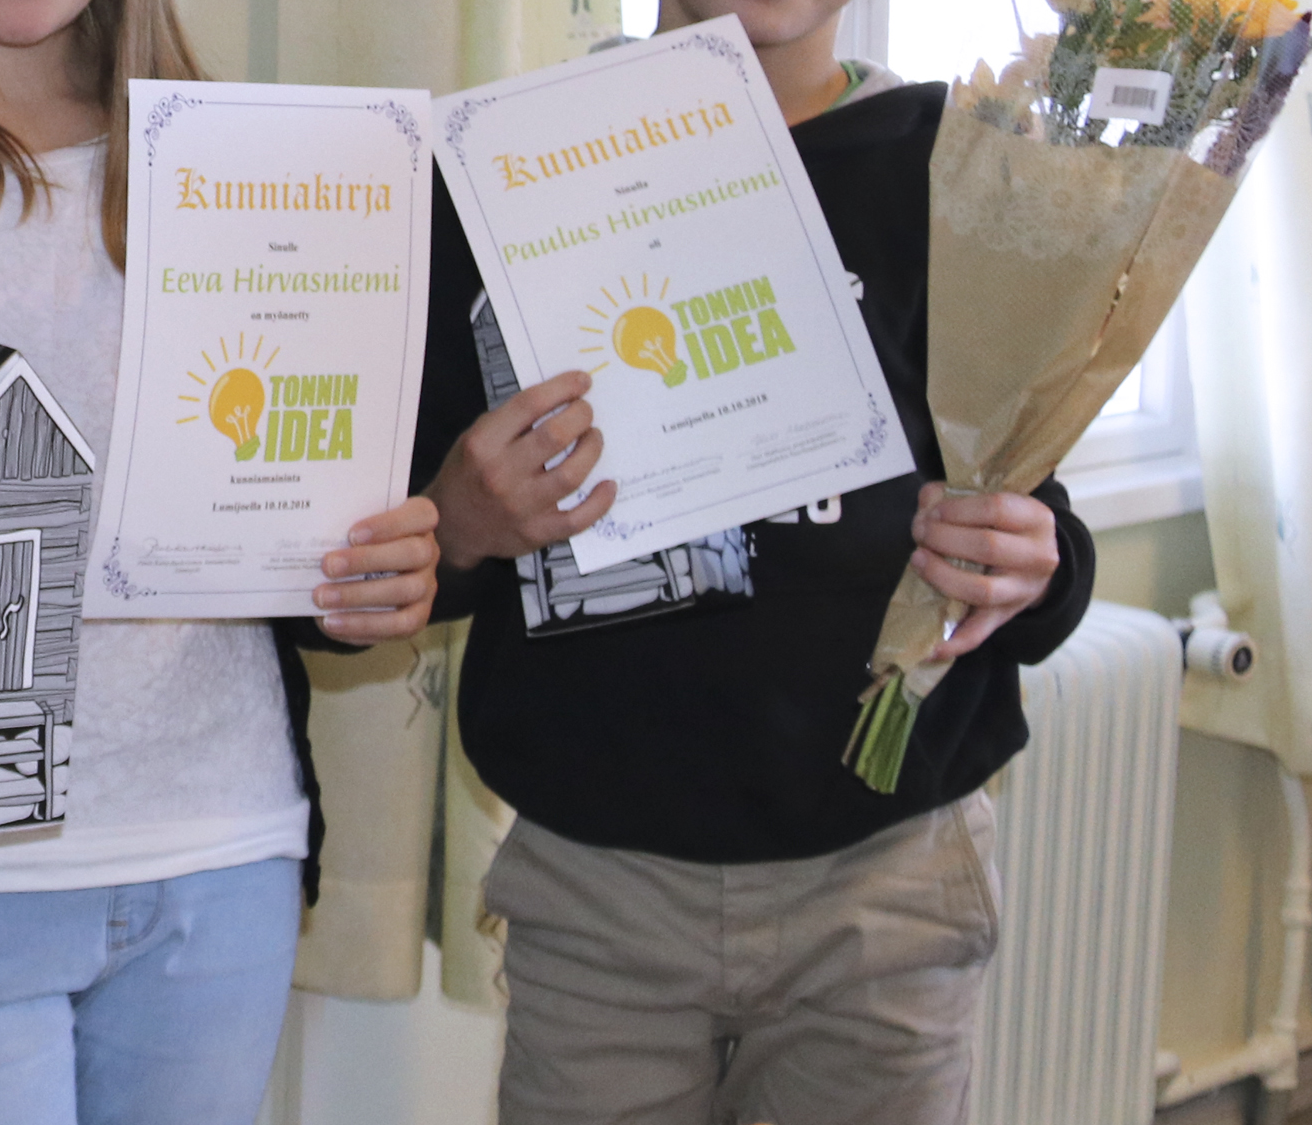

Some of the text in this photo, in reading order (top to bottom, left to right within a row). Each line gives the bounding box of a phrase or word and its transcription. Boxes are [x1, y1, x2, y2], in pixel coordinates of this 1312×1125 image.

[493, 99, 736, 191] Kunniakirja
[176, 167, 392, 219] Kunniakirja
[502, 163, 782, 265] Paulus Hirvasniemi
[161, 263, 402, 295] Eeva Hirvasniemi
[671, 275, 778, 331] TONNIN
[683, 307, 797, 381] IDEA
[269, 373, 360, 407] TONNIN
[263, 409, 354, 462] IDEA
[212, 500, 311, 514] Lumijoella 10.10.2018
